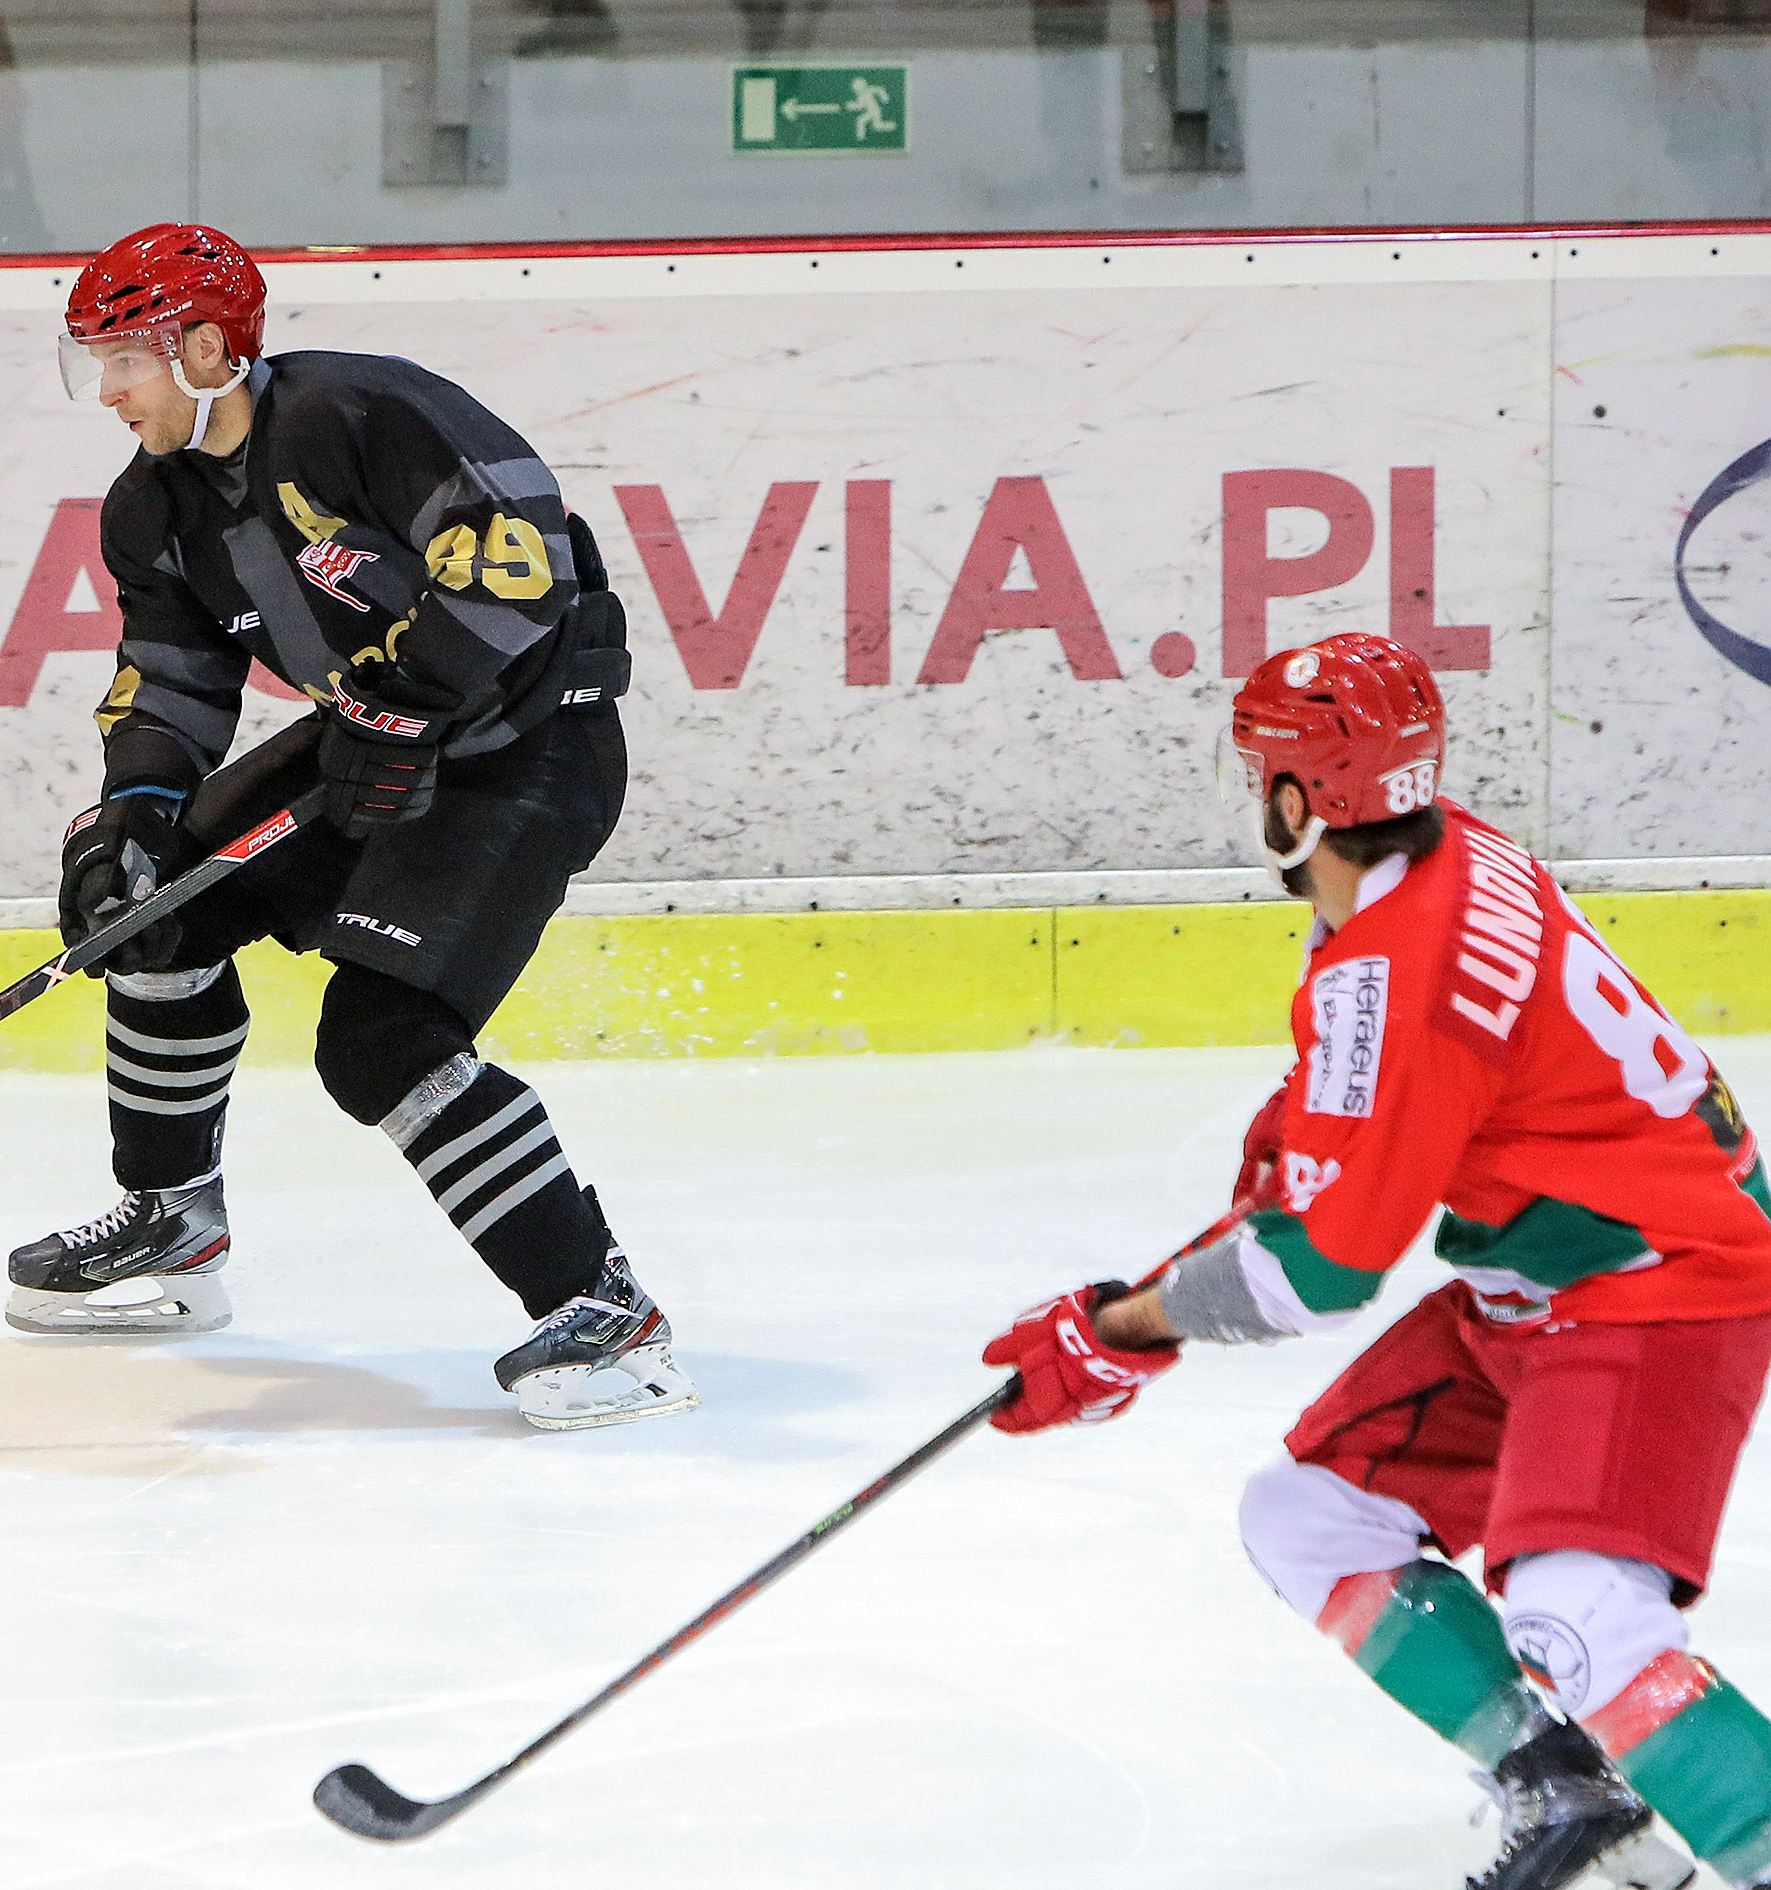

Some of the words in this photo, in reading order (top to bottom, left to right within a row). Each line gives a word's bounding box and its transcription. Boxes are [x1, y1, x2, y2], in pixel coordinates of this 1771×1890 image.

[147, 300, 193, 324] TRUE
[331, 683, 430, 739] RUE
[1389, 763, 1436, 815] 88
[336, 912, 423, 948] TRUE
[1343, 960, 1386, 1116] Heraeus
